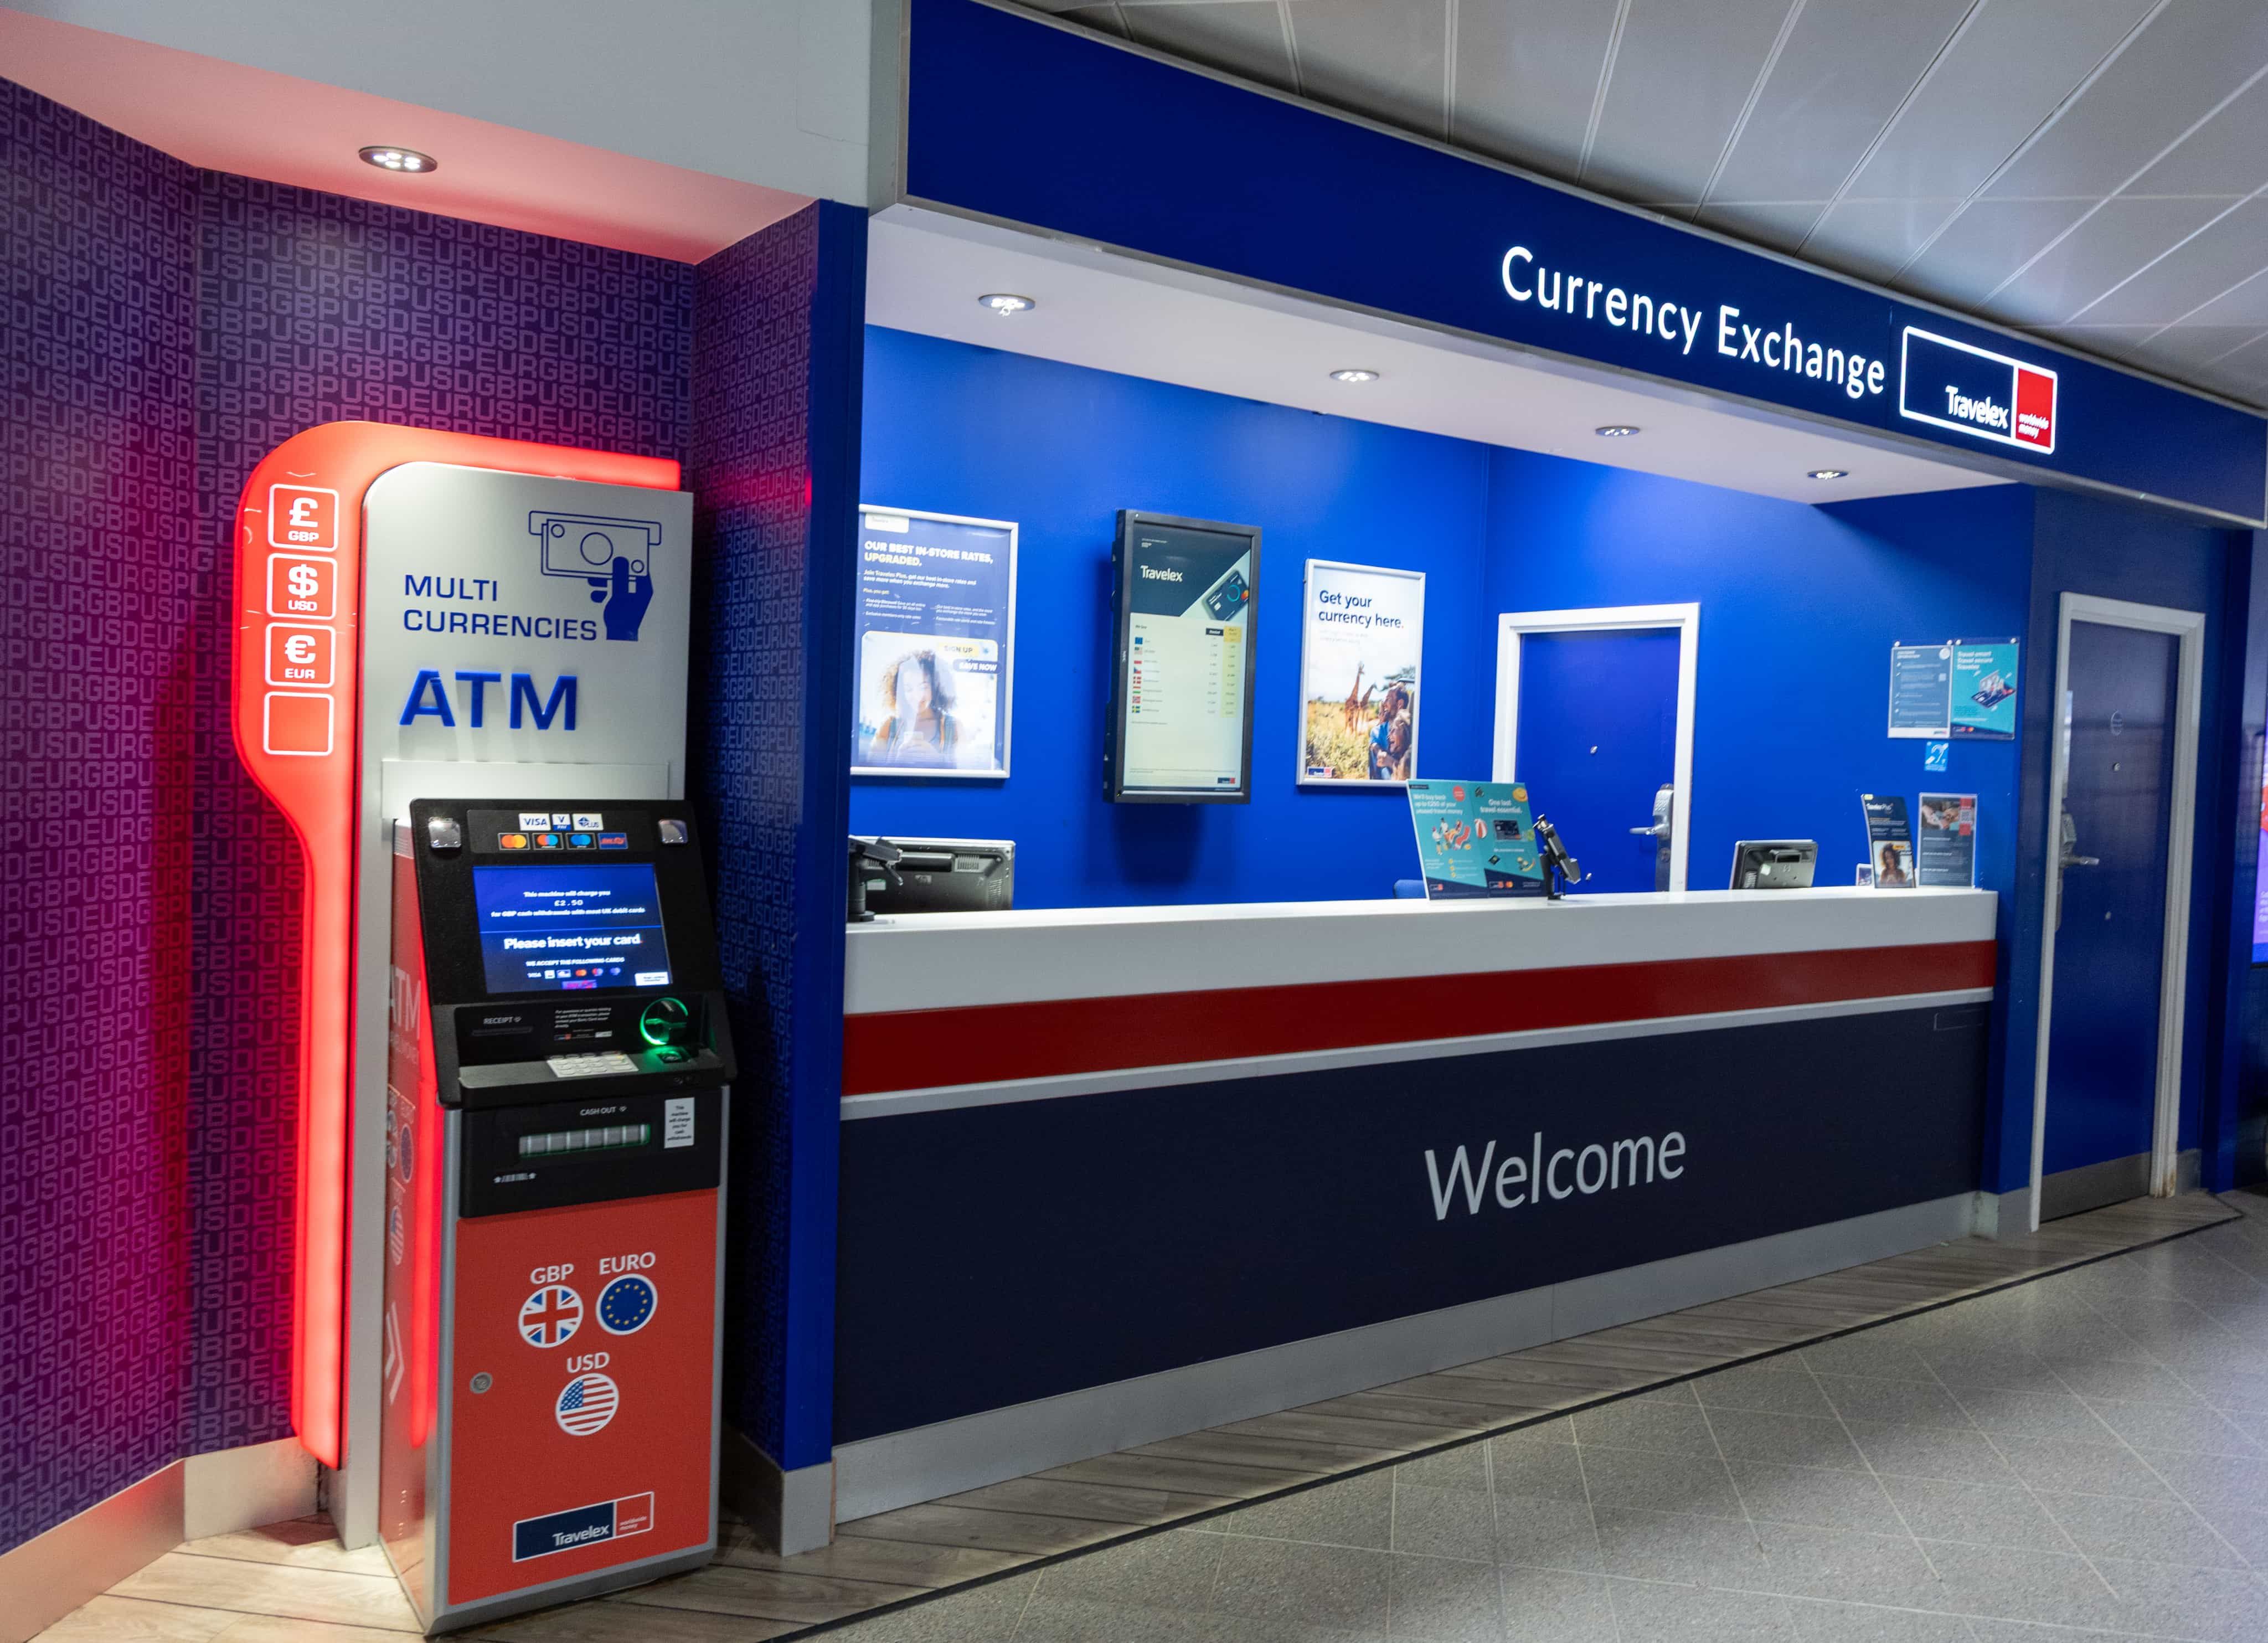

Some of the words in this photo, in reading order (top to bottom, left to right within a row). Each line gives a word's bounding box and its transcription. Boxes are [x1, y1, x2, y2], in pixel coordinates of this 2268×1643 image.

[1501, 245, 1702, 355] Currency
[1718, 305, 1885, 399] Exchange
[1945, 385, 2009, 429] Travelex
[289, 497, 318, 528] £
[288, 530, 319, 544] GBP
[864, 540, 887, 552] OUR
[889, 543, 914, 554] BEST
[915, 546, 960, 559] IN-STORE
[961, 551, 993, 564] RATES,
[288, 563, 319, 599] $
[1140, 565, 1183, 582] Travelex
[404, 574, 498, 602] MULTI
[288, 599, 318, 612] USD
[1319, 590, 1342, 605] Get
[1345, 594, 1372, 609] your
[404, 609, 597, 641] CURRENCIES
[1319, 611, 1372, 628] currency
[1375, 613, 1404, 629] here.
[285, 634, 316, 665] €
[285, 668, 316, 680] EUR
[979, 663, 997, 672] NOW
[399, 669, 578, 731] ATM
[503, 938, 547, 949] Please
[547, 936, 584, 947] insert
[585, 936, 612, 949] your
[483, 1017, 512, 1026] RECEIPT
[580, 1108, 599, 1116] CASH
[600, 1106, 616, 1115] OUT
[1424, 1131, 1686, 1220] Welcome
[530, 1263, 574, 1285] GBP
[599, 1252, 656, 1275] EURO
[566, 1351, 610, 1373] USD
[553, 1524, 610, 1546] Travelex
